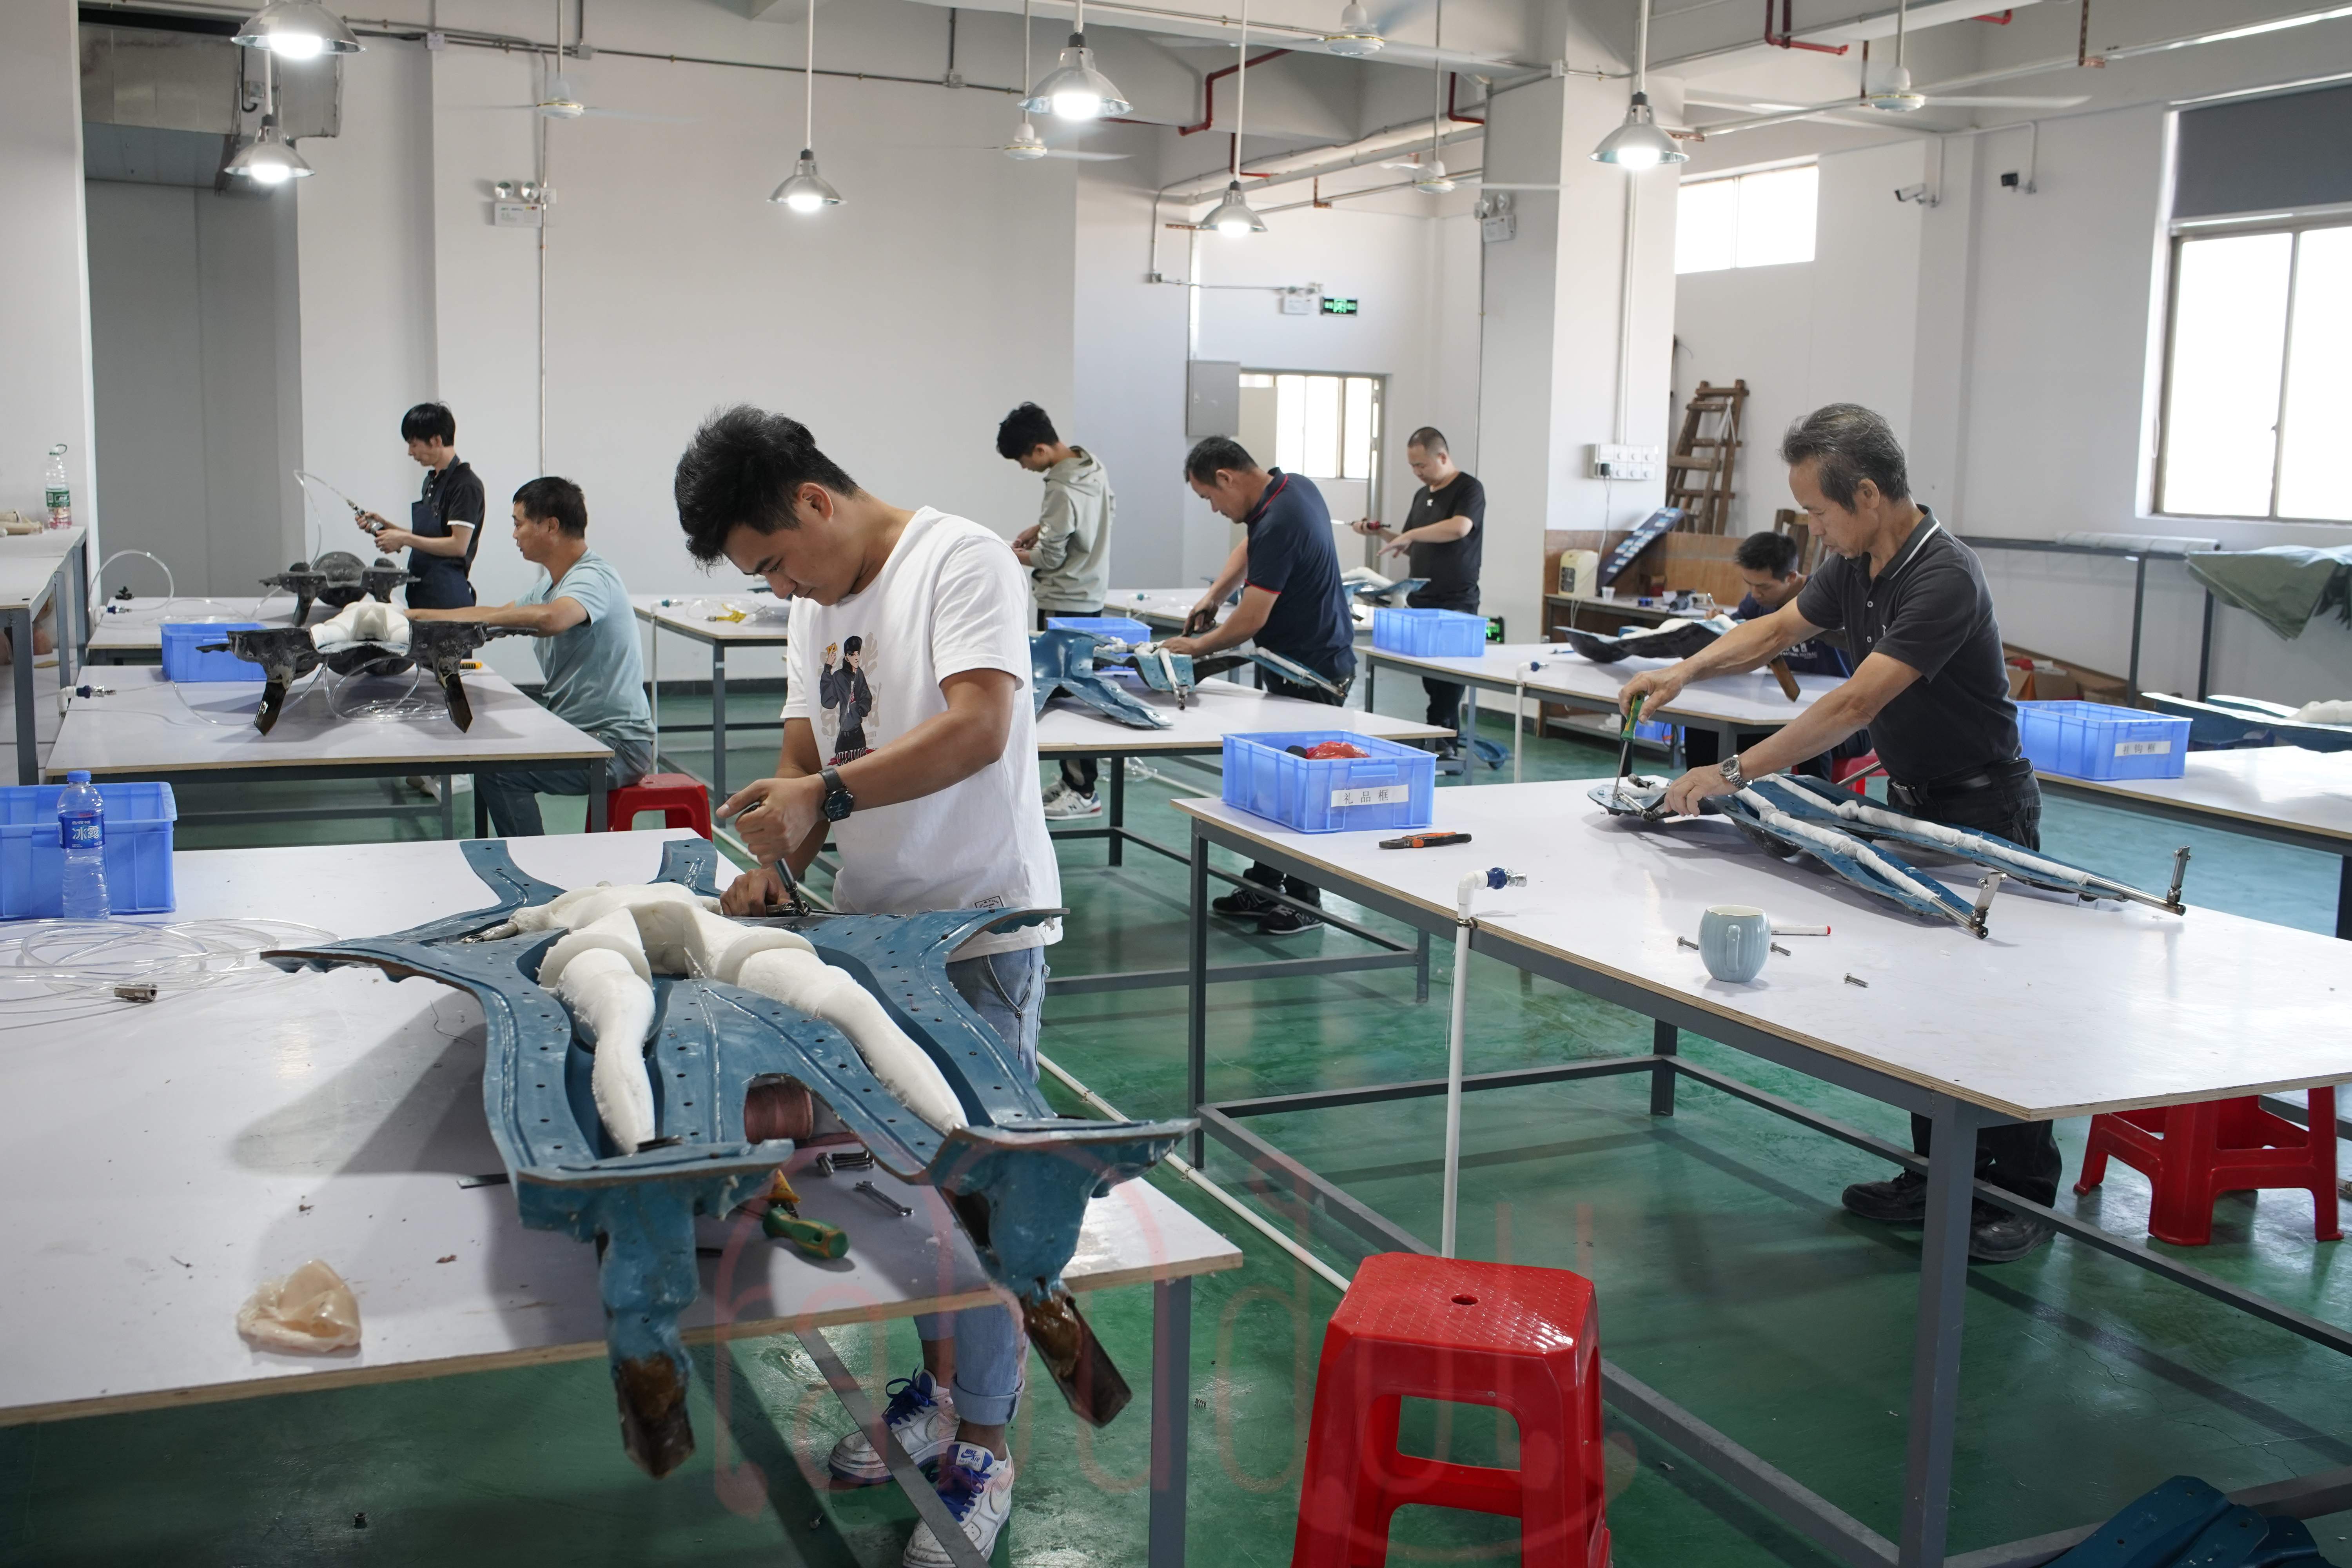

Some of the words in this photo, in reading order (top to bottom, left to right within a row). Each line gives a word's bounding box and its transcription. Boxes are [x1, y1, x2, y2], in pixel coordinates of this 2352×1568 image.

[1343, 789, 1389, 805] 礼品框
[72, 825, 99, 840] 冰露
